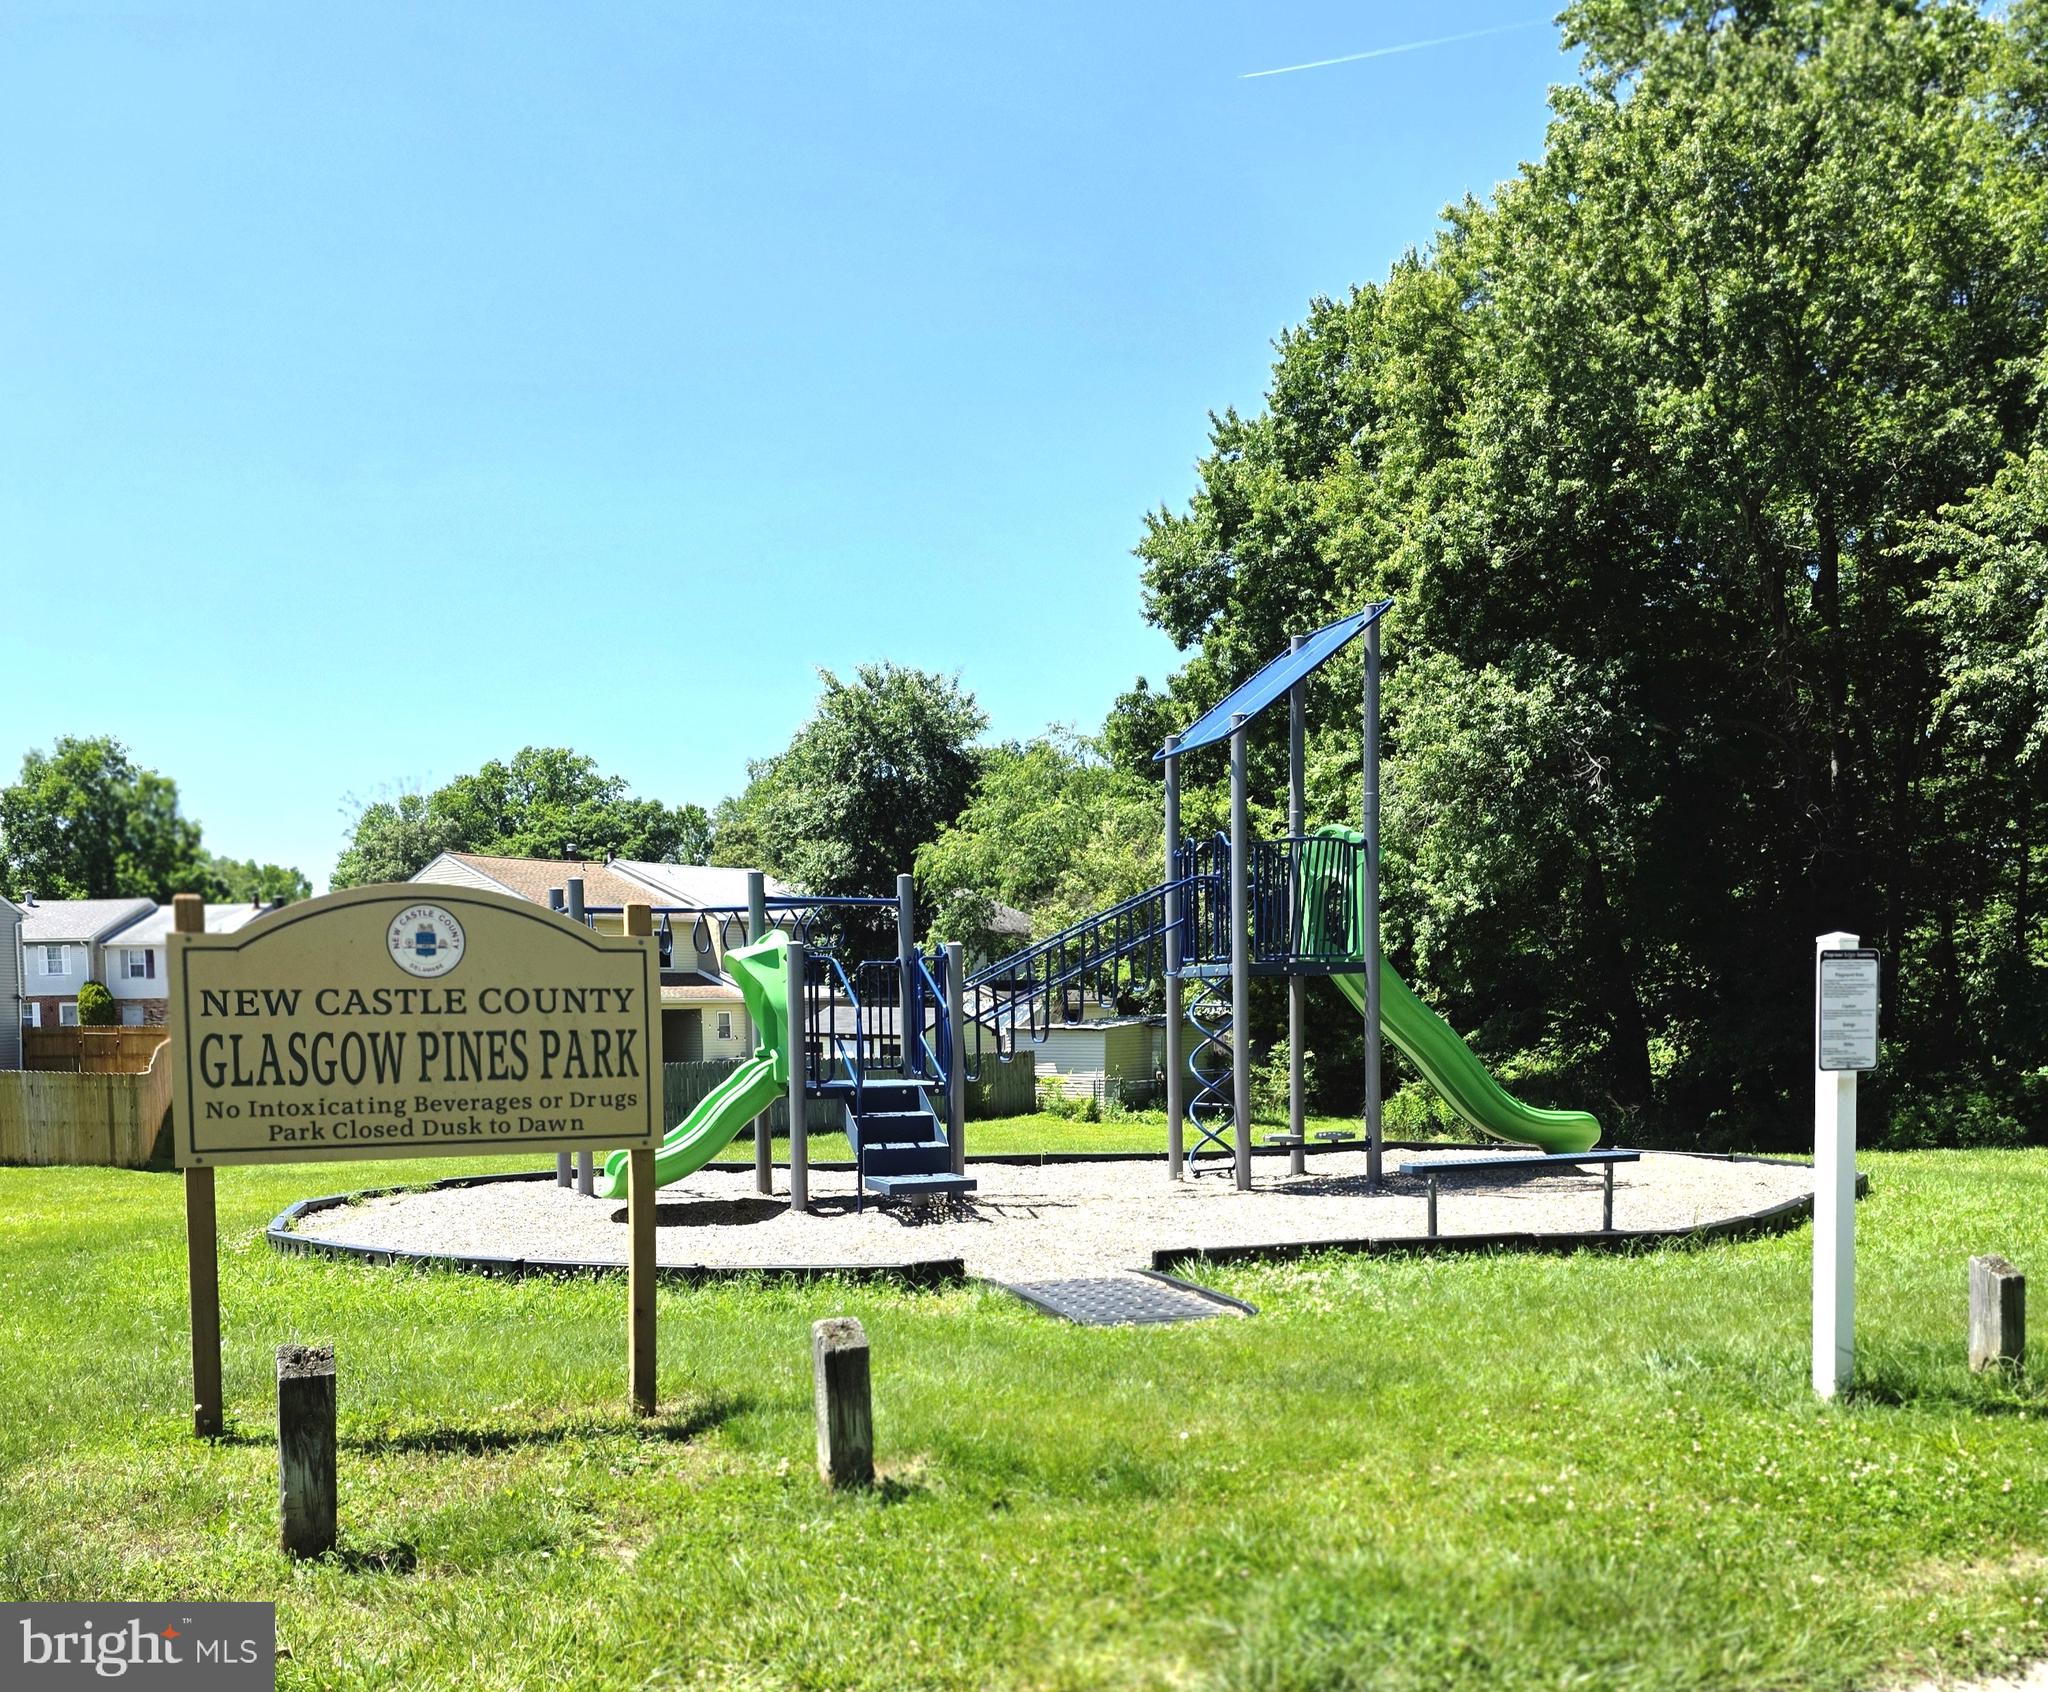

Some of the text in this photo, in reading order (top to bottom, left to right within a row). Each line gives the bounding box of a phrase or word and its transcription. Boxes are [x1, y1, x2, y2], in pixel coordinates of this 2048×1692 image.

[392, 909, 460, 950] NEW CASTLE COUNTY
[200, 987, 635, 1017] NEW CASTLE COUNTY
[199, 1028, 640, 1089] GLASGOW PINES PARK
[205, 1091, 638, 1120] No Intoxicating Beverages or Drugs
[268, 1116, 585, 1142] Park Closed Dusk to Dawn
